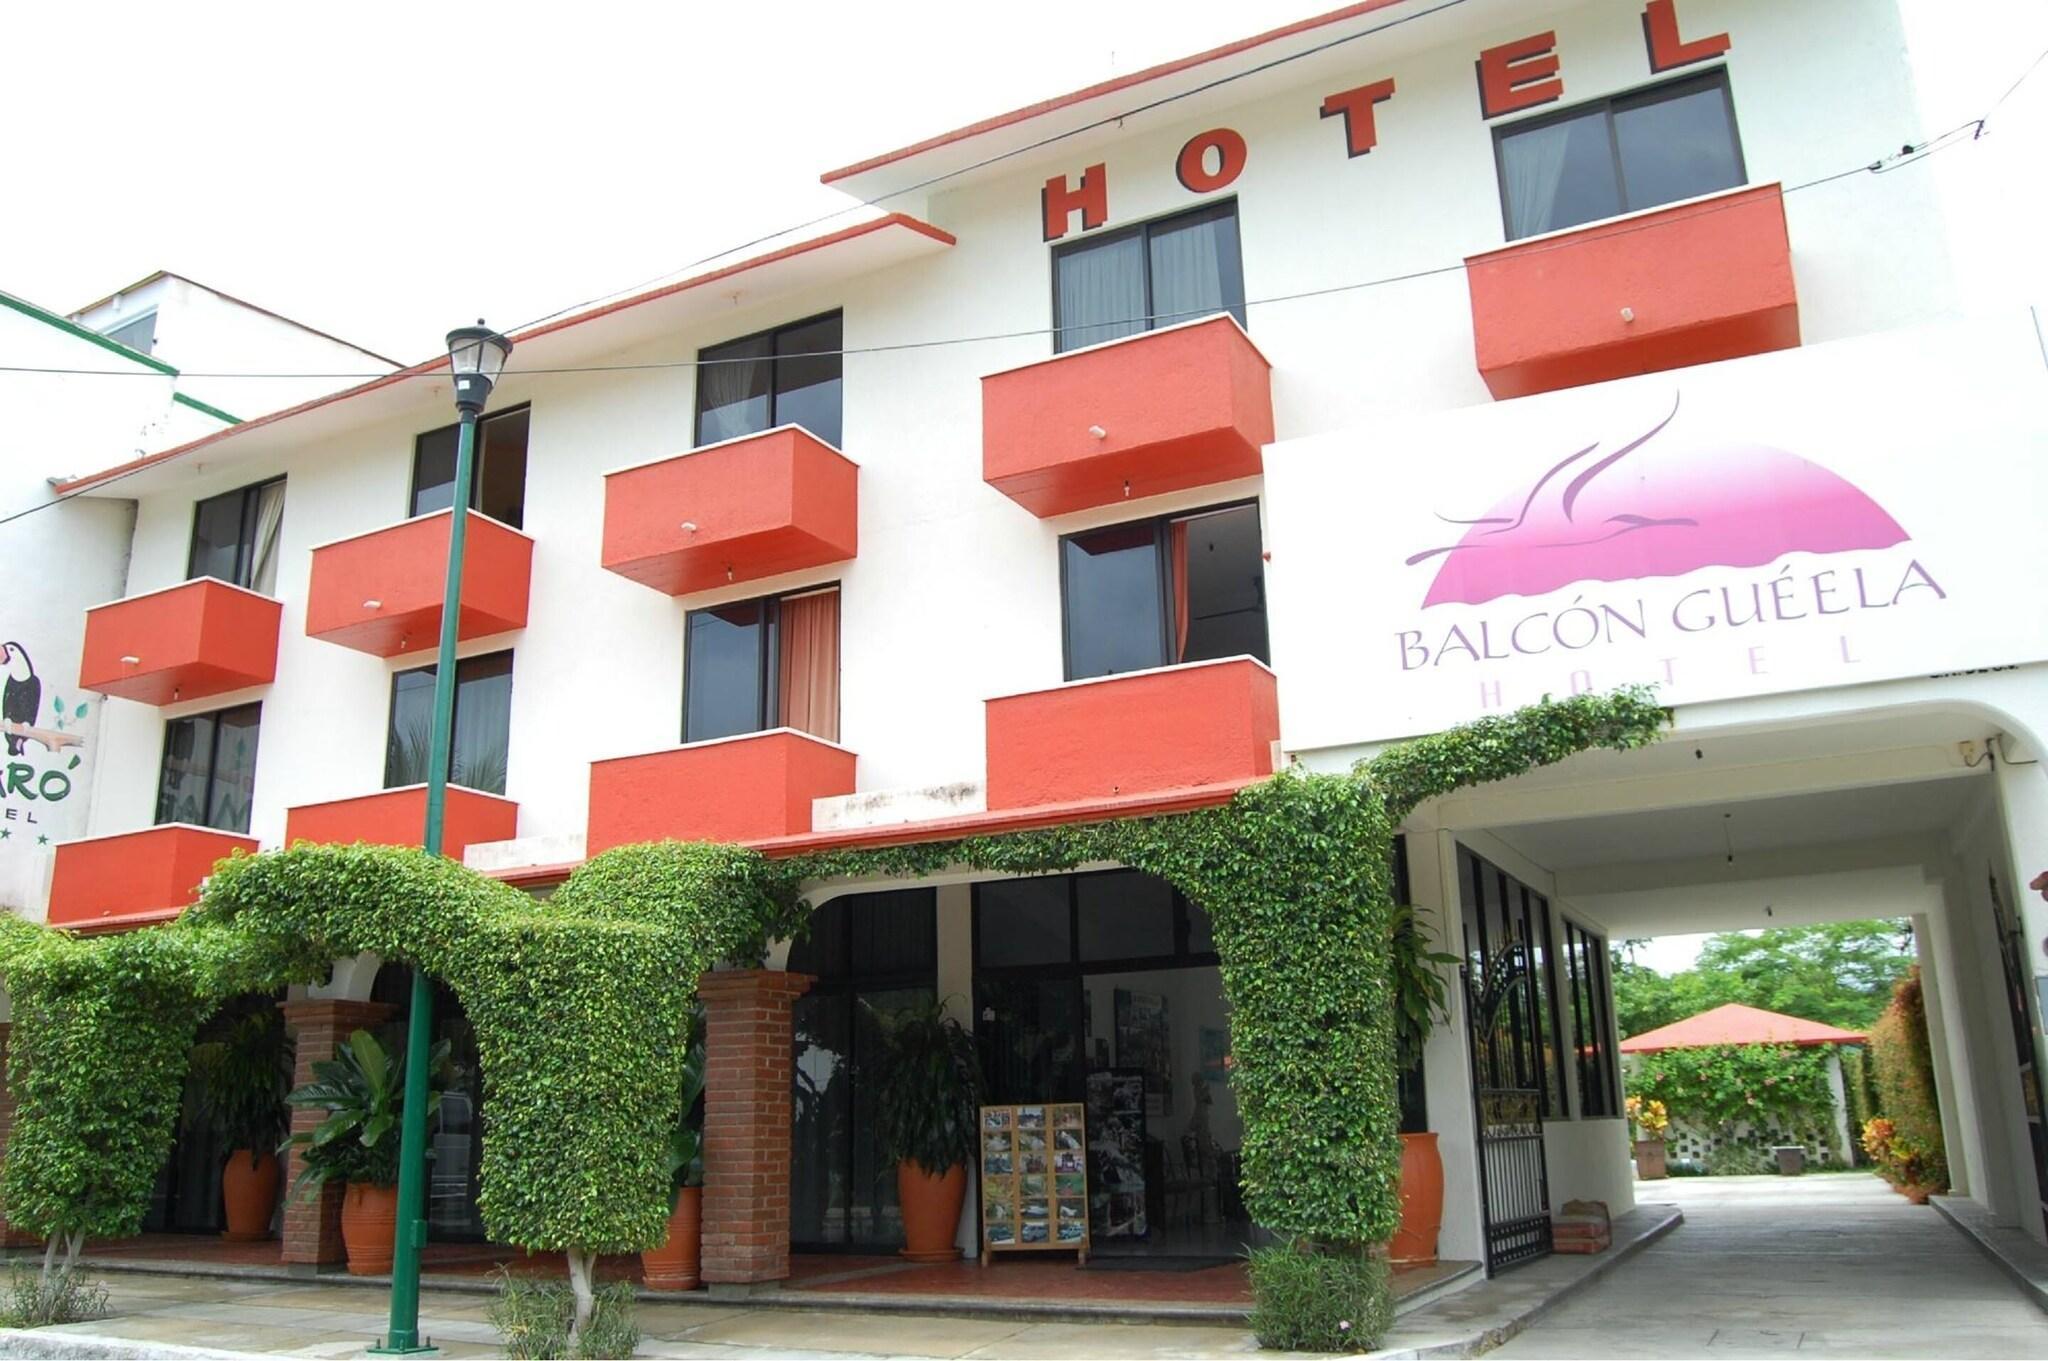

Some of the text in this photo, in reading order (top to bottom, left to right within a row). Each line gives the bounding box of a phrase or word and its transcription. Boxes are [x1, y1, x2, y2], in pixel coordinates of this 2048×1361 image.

[1042, 0, 1731, 241] HOTEL
[1396, 558, 1947, 671] BALCÓN GUÉELA
[1479, 635, 1862, 709] HOTEL
